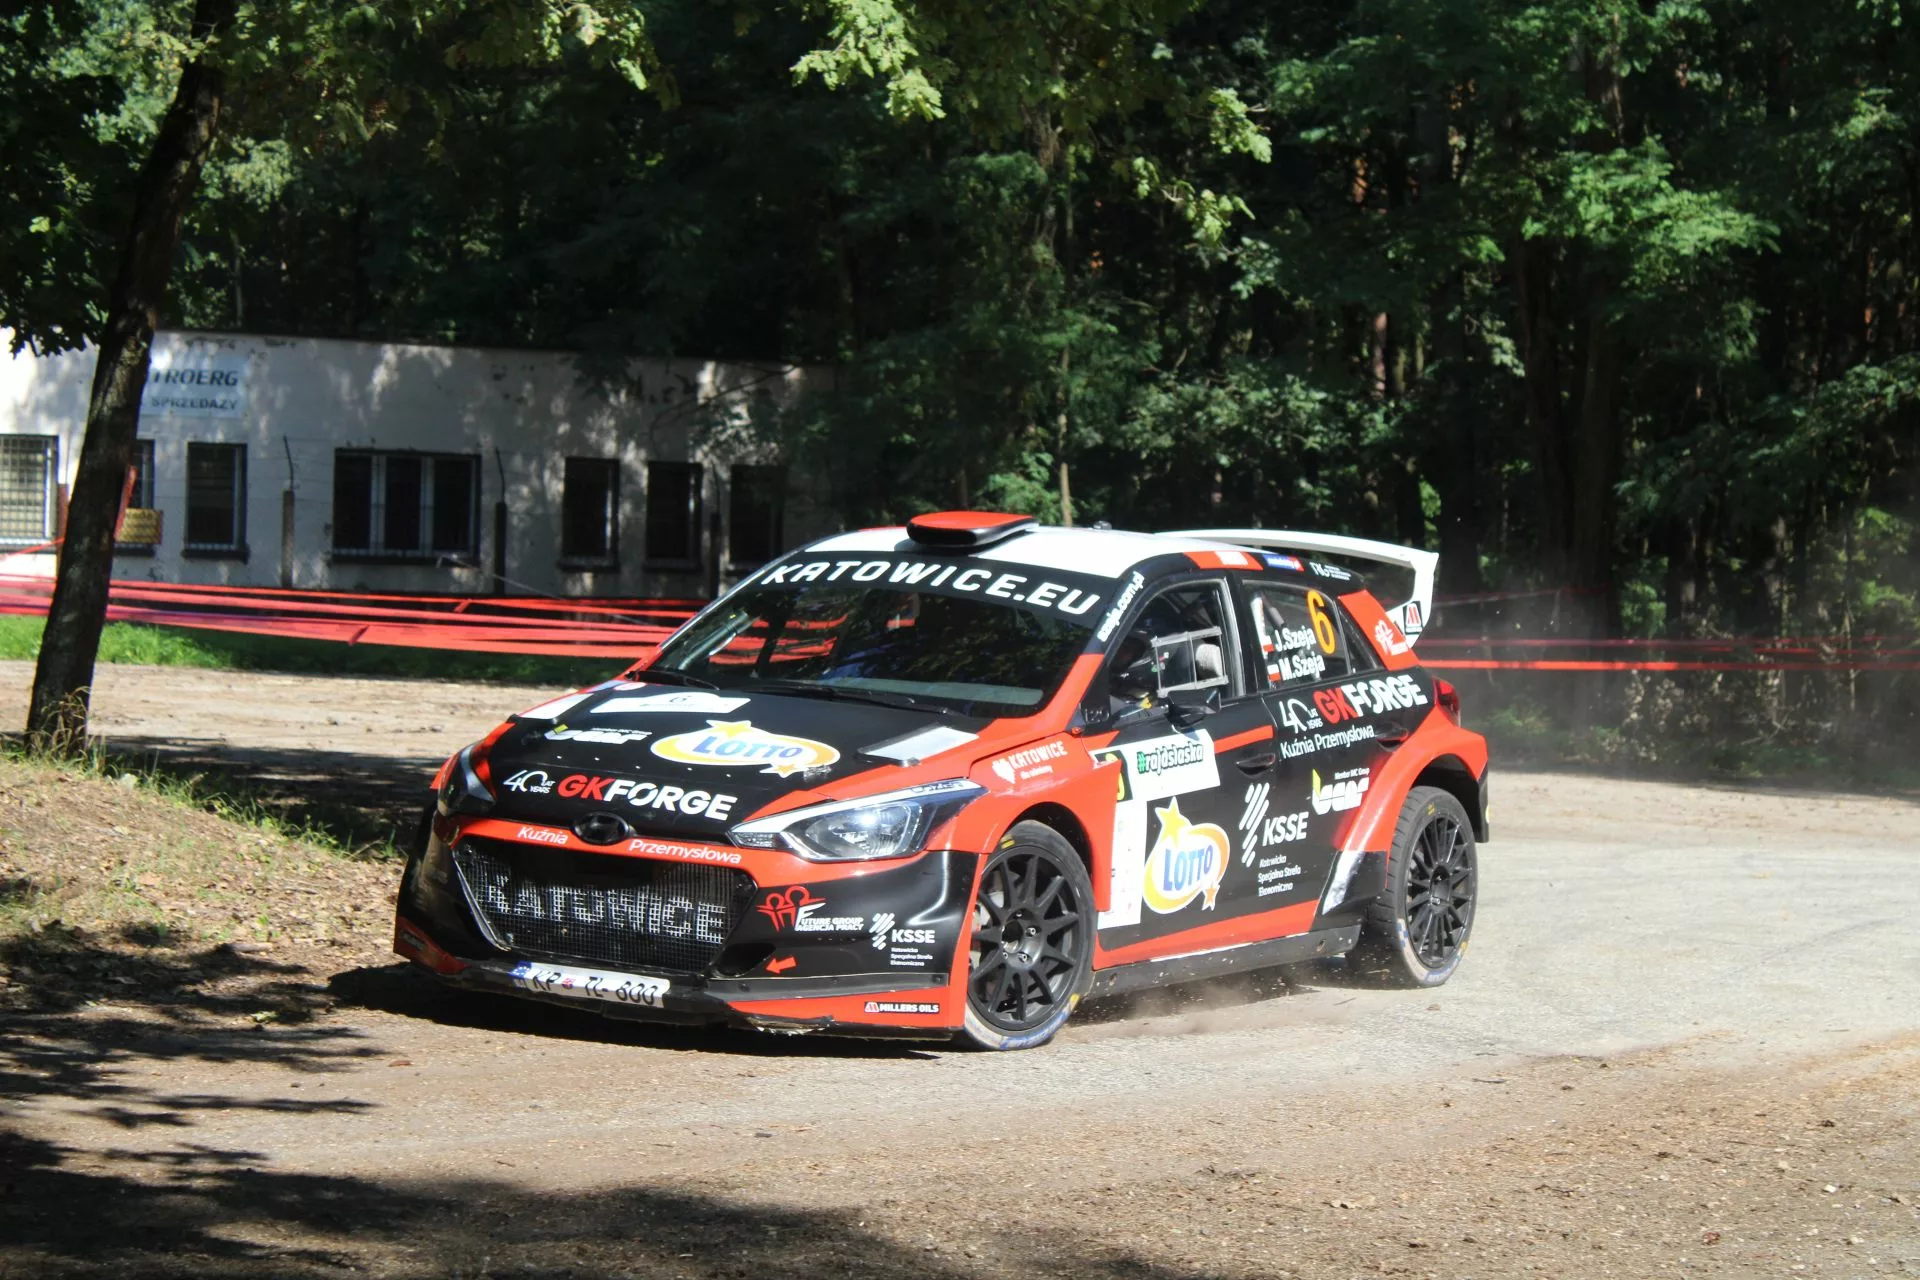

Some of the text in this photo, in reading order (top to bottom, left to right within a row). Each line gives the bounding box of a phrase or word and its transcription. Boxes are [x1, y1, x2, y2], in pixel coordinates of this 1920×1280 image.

[760, 560, 1101, 616] KATOWICE.EU
[1273, 625, 1317, 653] J.Szeja
[1307, 589, 1336, 655] 6
[1278, 650, 1326, 681] M.Szeja
[1312, 674, 1428, 725] GKFORGE
[699, 735, 804, 759] LOTTO
[1007, 740, 1068, 770] KATOWICE
[1280, 724, 1376, 760] Kuźnia Przemysłowa
[557, 774, 738, 822] GKFORGE
[517, 825, 743, 865] Kuźnia Przemysłowa
[1262, 811, 1310, 847] KSSE
[1163, 844, 1213, 892] LOTTO
[891, 929, 936, 944] KSSE
[880, 1003, 939, 1013] MILLERS OILS
